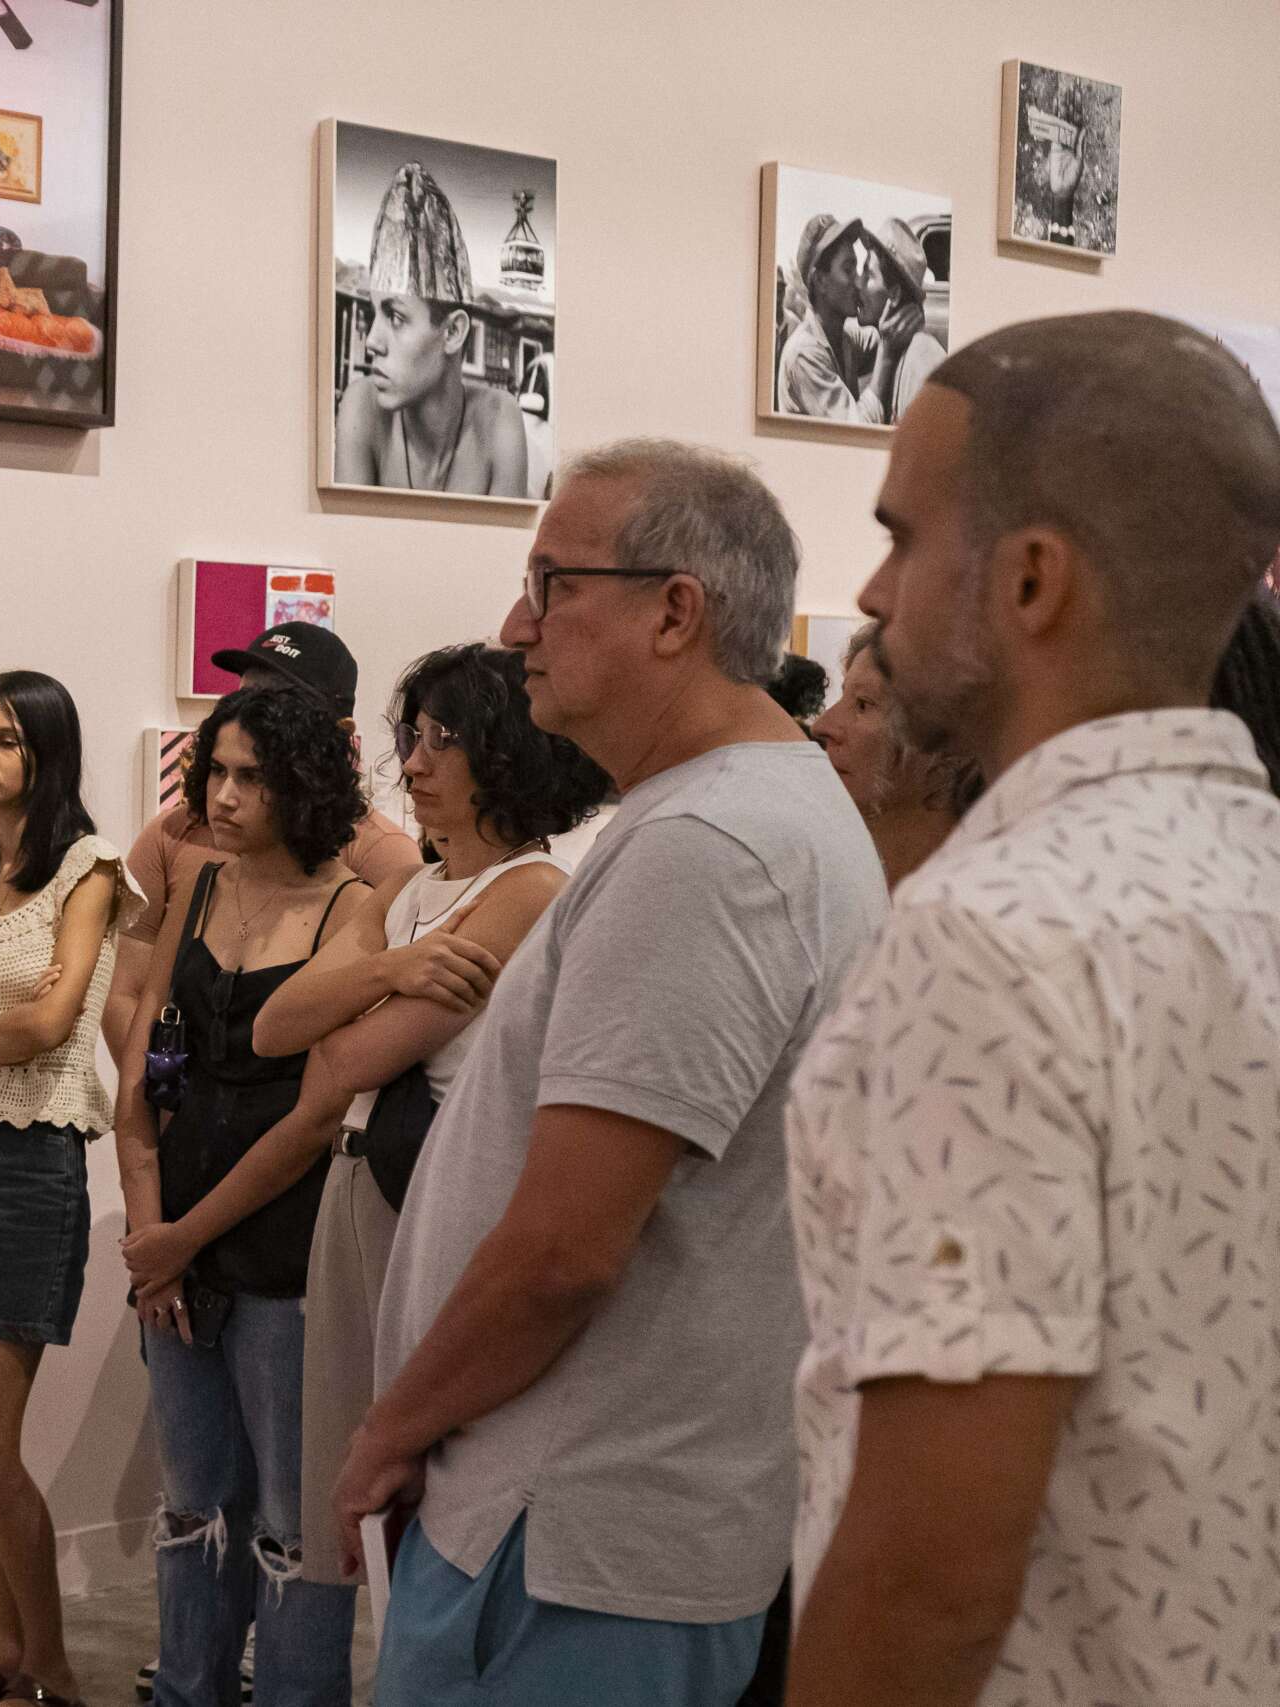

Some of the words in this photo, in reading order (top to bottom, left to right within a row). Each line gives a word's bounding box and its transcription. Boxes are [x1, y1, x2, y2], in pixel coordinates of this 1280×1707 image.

[270, 635, 290, 644] JUST
[275, 644, 290, 654] DO
[288, 649, 301, 659] IT
